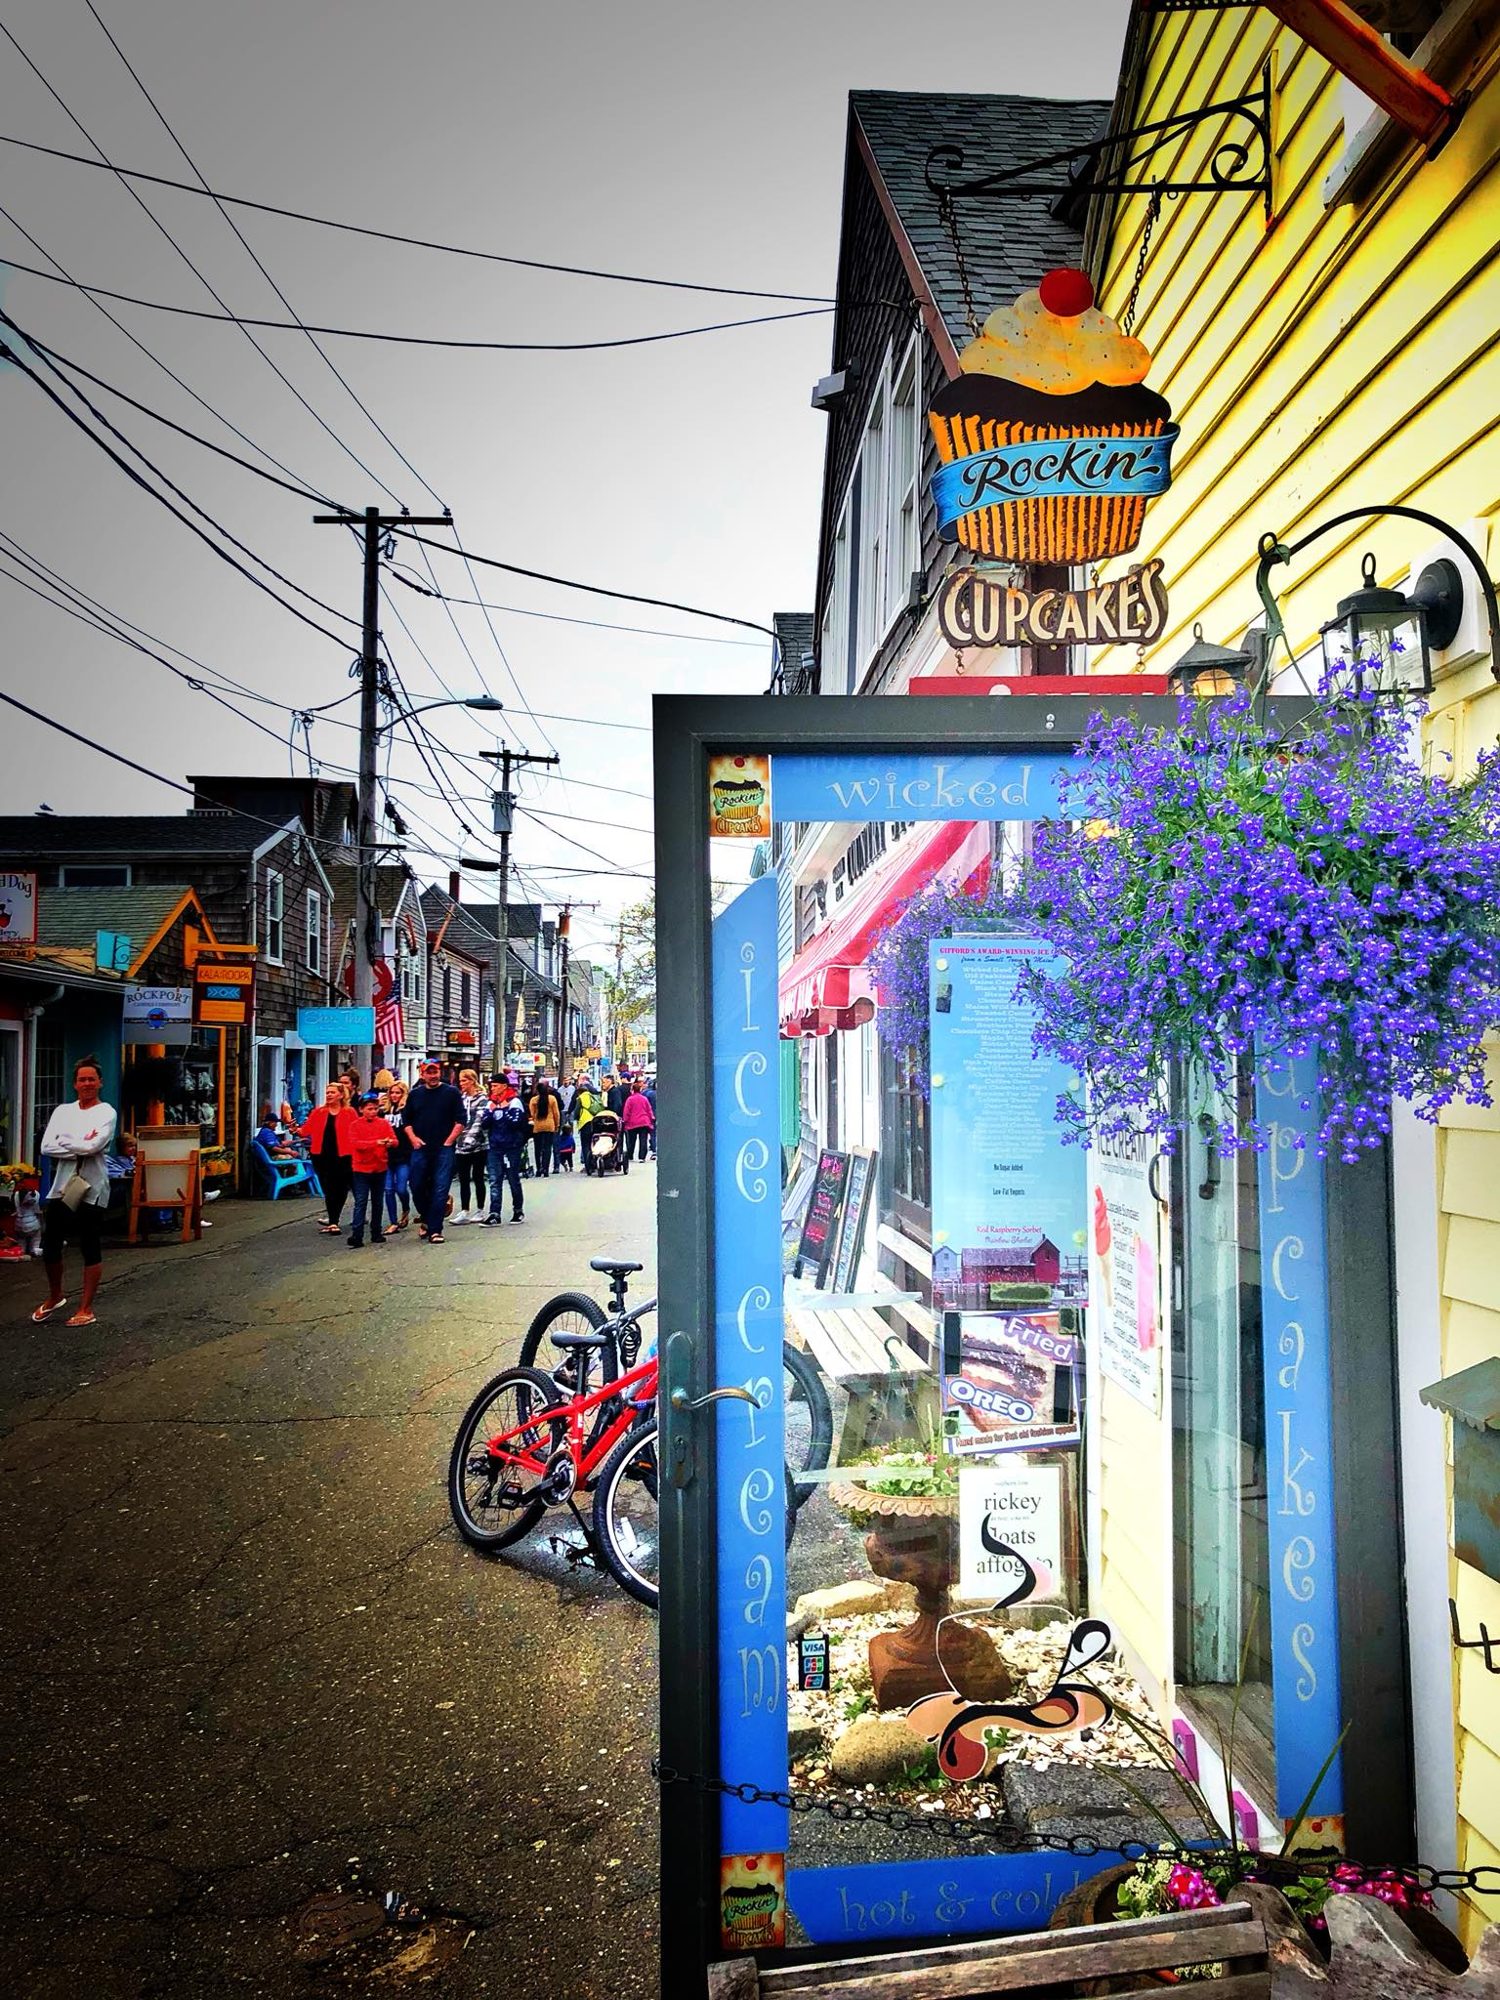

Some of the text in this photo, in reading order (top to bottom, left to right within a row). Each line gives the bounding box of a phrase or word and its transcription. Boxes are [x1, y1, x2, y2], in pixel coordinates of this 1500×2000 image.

[959, 441, 1161, 507] Rockin'
[944, 561, 1161, 641] CUPCAKES
[826, 764, 1034, 810] wicked
[720, 793, 759, 808] Rockin'
[716, 815, 762, 834] CUPCAKES
[9, 875, 32, 898] Dog
[127, 990, 190, 1004] ROCKPORT
[1008, 1317, 1073, 1360] Fried
[1262, 1034, 1316, 1703] upcakes
[950, 1380, 1034, 1422] OREO
[984, 1492, 1042, 1514] rickey
[990, 1526, 1036, 1544] loats
[804, 1644, 825, 1652] VISA
[730, 1899, 773, 1918] Rockin'
[837, 1886, 915, 1932] hot
[936, 1880, 975, 1922] &
